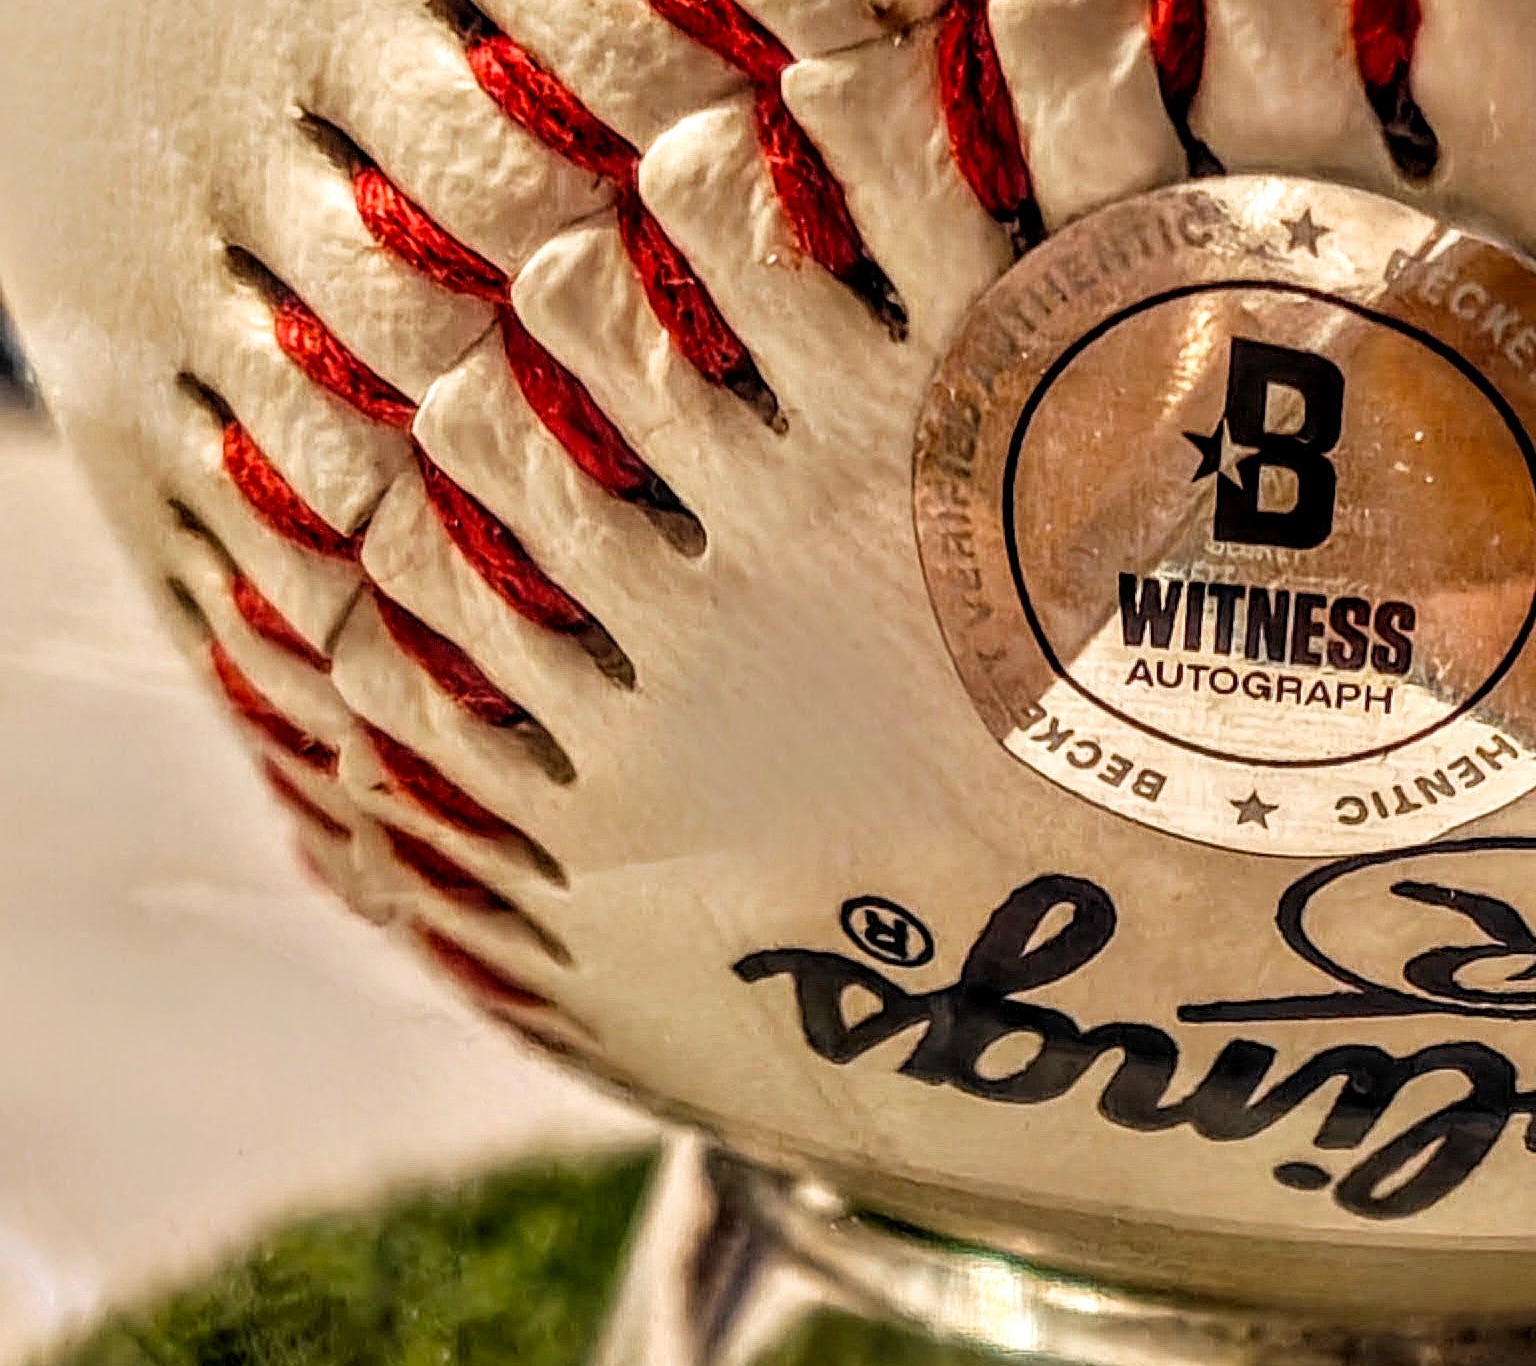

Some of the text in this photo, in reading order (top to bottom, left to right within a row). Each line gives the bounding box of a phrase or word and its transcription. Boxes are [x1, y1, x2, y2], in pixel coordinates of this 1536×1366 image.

[1212, 335, 1346, 551] B
[1117, 570, 1417, 677] WITNESS
[1124, 657, 1395, 715] AUTOGRAPH
